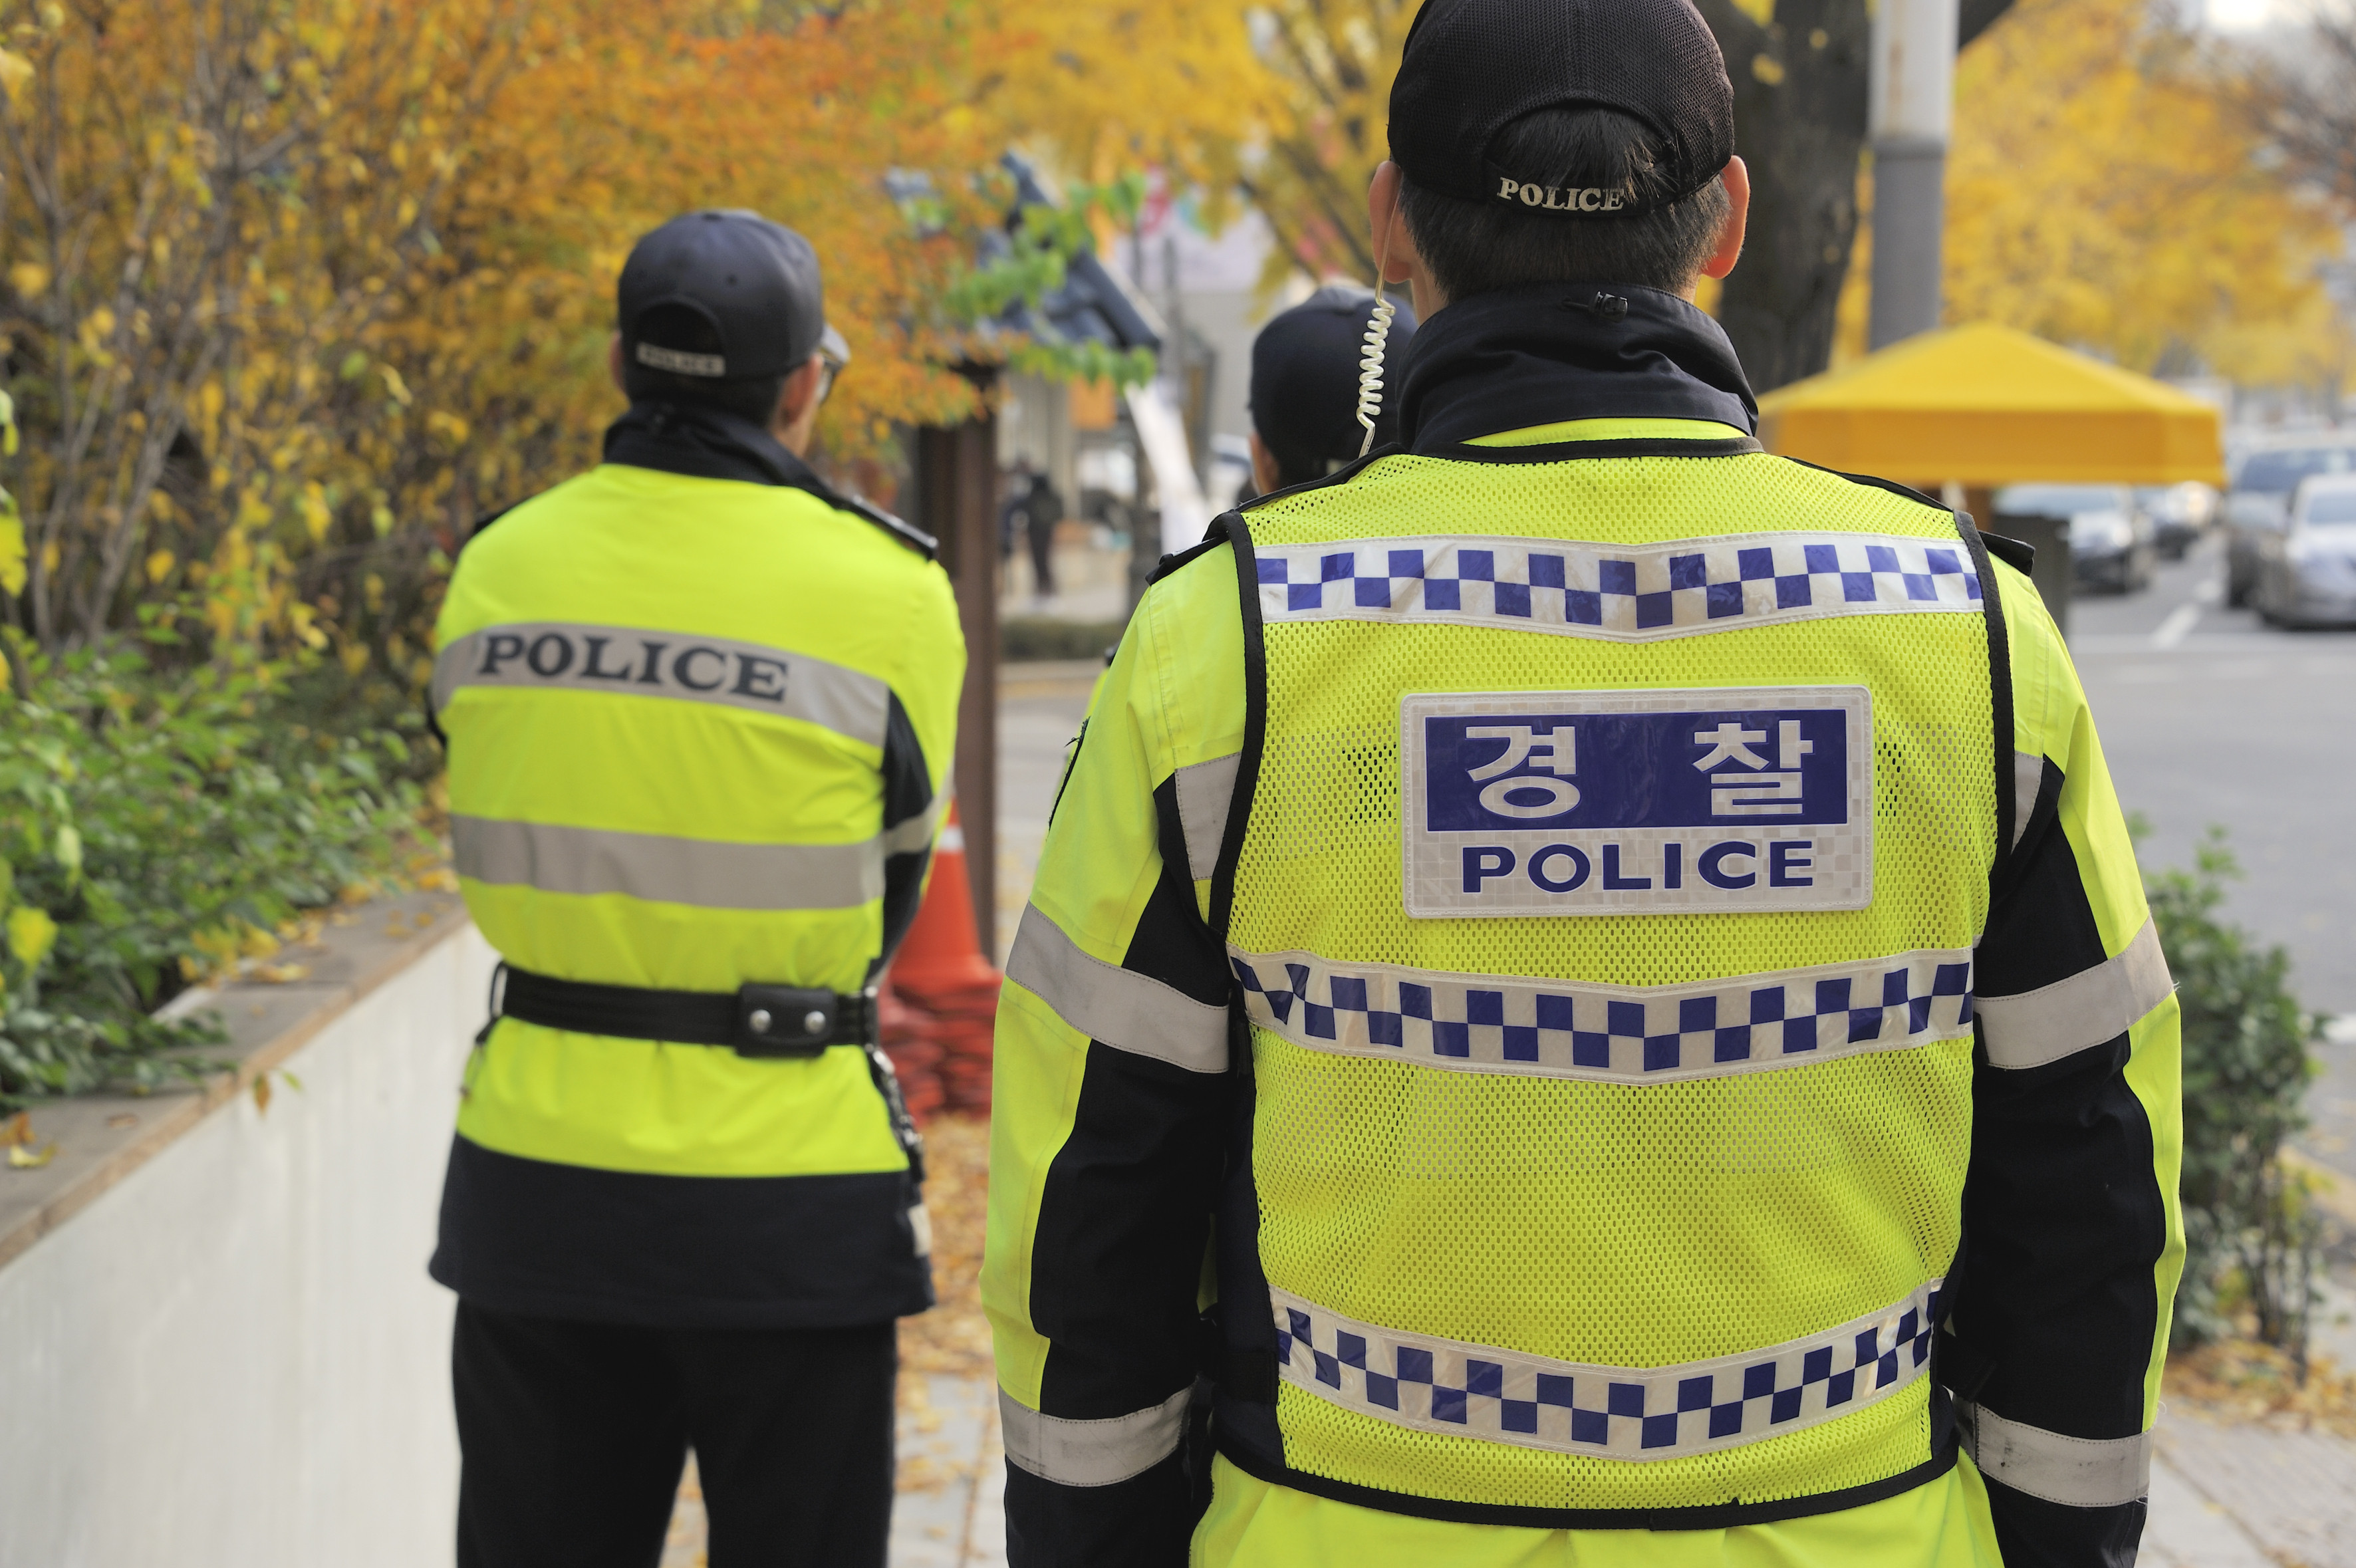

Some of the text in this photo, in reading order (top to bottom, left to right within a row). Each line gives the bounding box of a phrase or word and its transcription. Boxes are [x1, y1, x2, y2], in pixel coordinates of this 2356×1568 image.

[1497, 177, 1624, 211] POLICE
[477, 632, 789, 702] POLICE
[1463, 841, 1813, 893] POLICE
